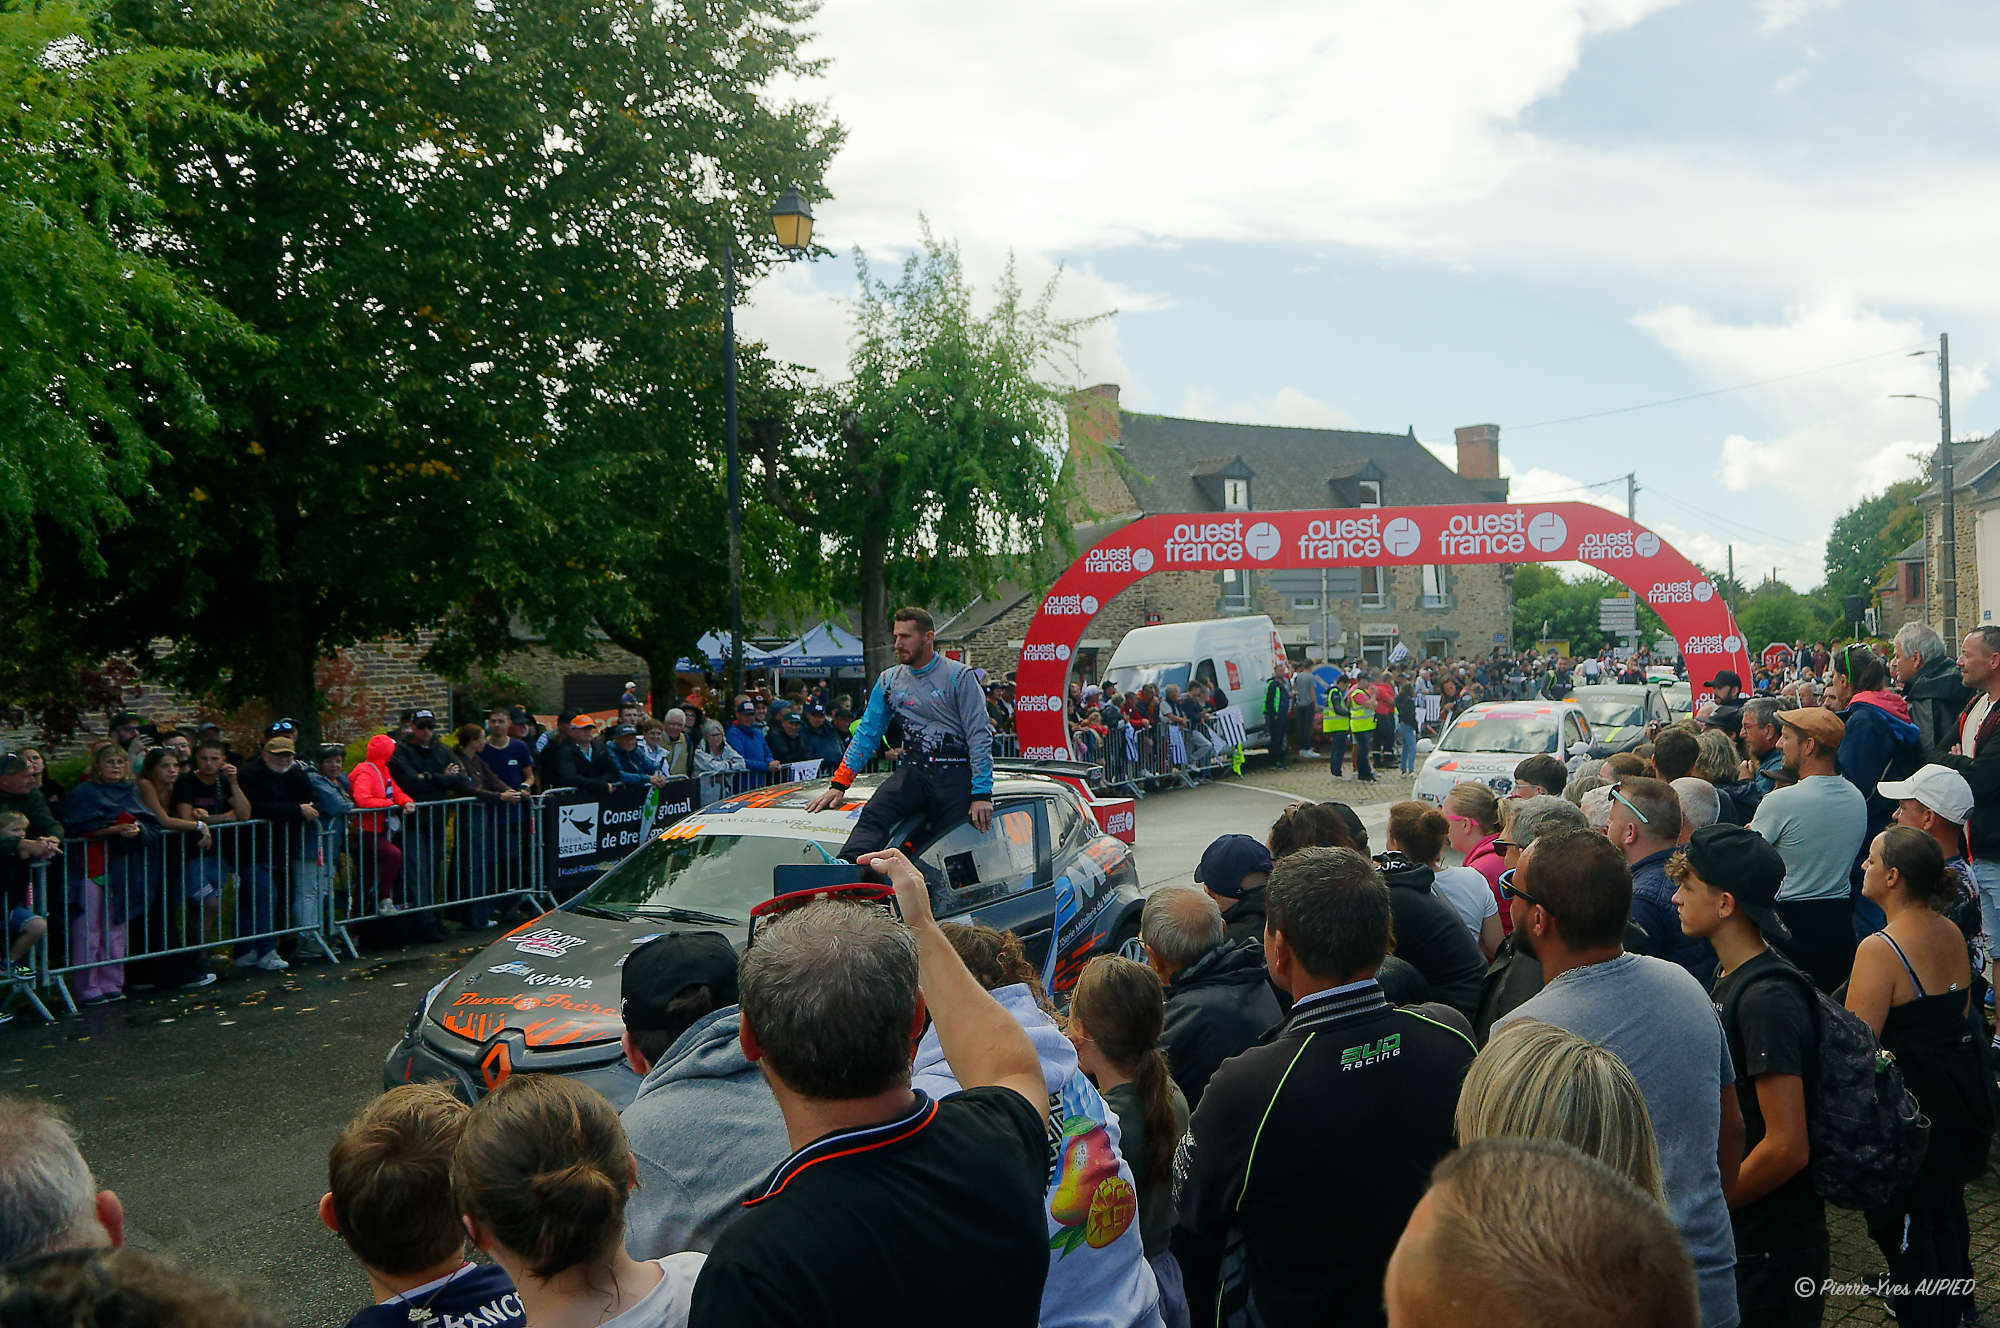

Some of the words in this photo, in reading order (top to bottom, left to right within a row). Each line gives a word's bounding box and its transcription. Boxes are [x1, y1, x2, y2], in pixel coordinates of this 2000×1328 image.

[1308, 514, 1381, 539] ouest
[1449, 509, 1525, 534] ouest
[1174, 518, 1243, 543] ouest
[1585, 530, 1633, 546] ouest
[1164, 539, 1243, 562] france
[1298, 536, 1381, 559] france
[1439, 531, 1525, 556] france
[1579, 543, 1633, 559] france
[1090, 546, 1131, 561] ouest
[1085, 557, 1131, 572] france
[1653, 580, 1692, 593] ouest
[1048, 594, 1080, 606] ouest
[1648, 589, 1692, 602] france
[1044, 602, 1080, 615] france
[1027, 642, 1055, 652] ouest
[1689, 634, 1722, 645] ouest
[1024, 650, 1055, 661] france
[1685, 644, 1722, 654] france
[1018, 701, 1047, 711] france
[1021, 694, 1047, 704] ouest
[1027, 746, 1054, 756] ouest
[603, 807, 641, 825] Consei
[1109, 811, 1125, 824] ouest
[1107, 822, 1126, 834] france
[602, 832, 616, 848] de
[523, 973, 593, 989] Kubota
[452, 992, 525, 1007] Duval
[541, 993, 622, 1018] Frère
